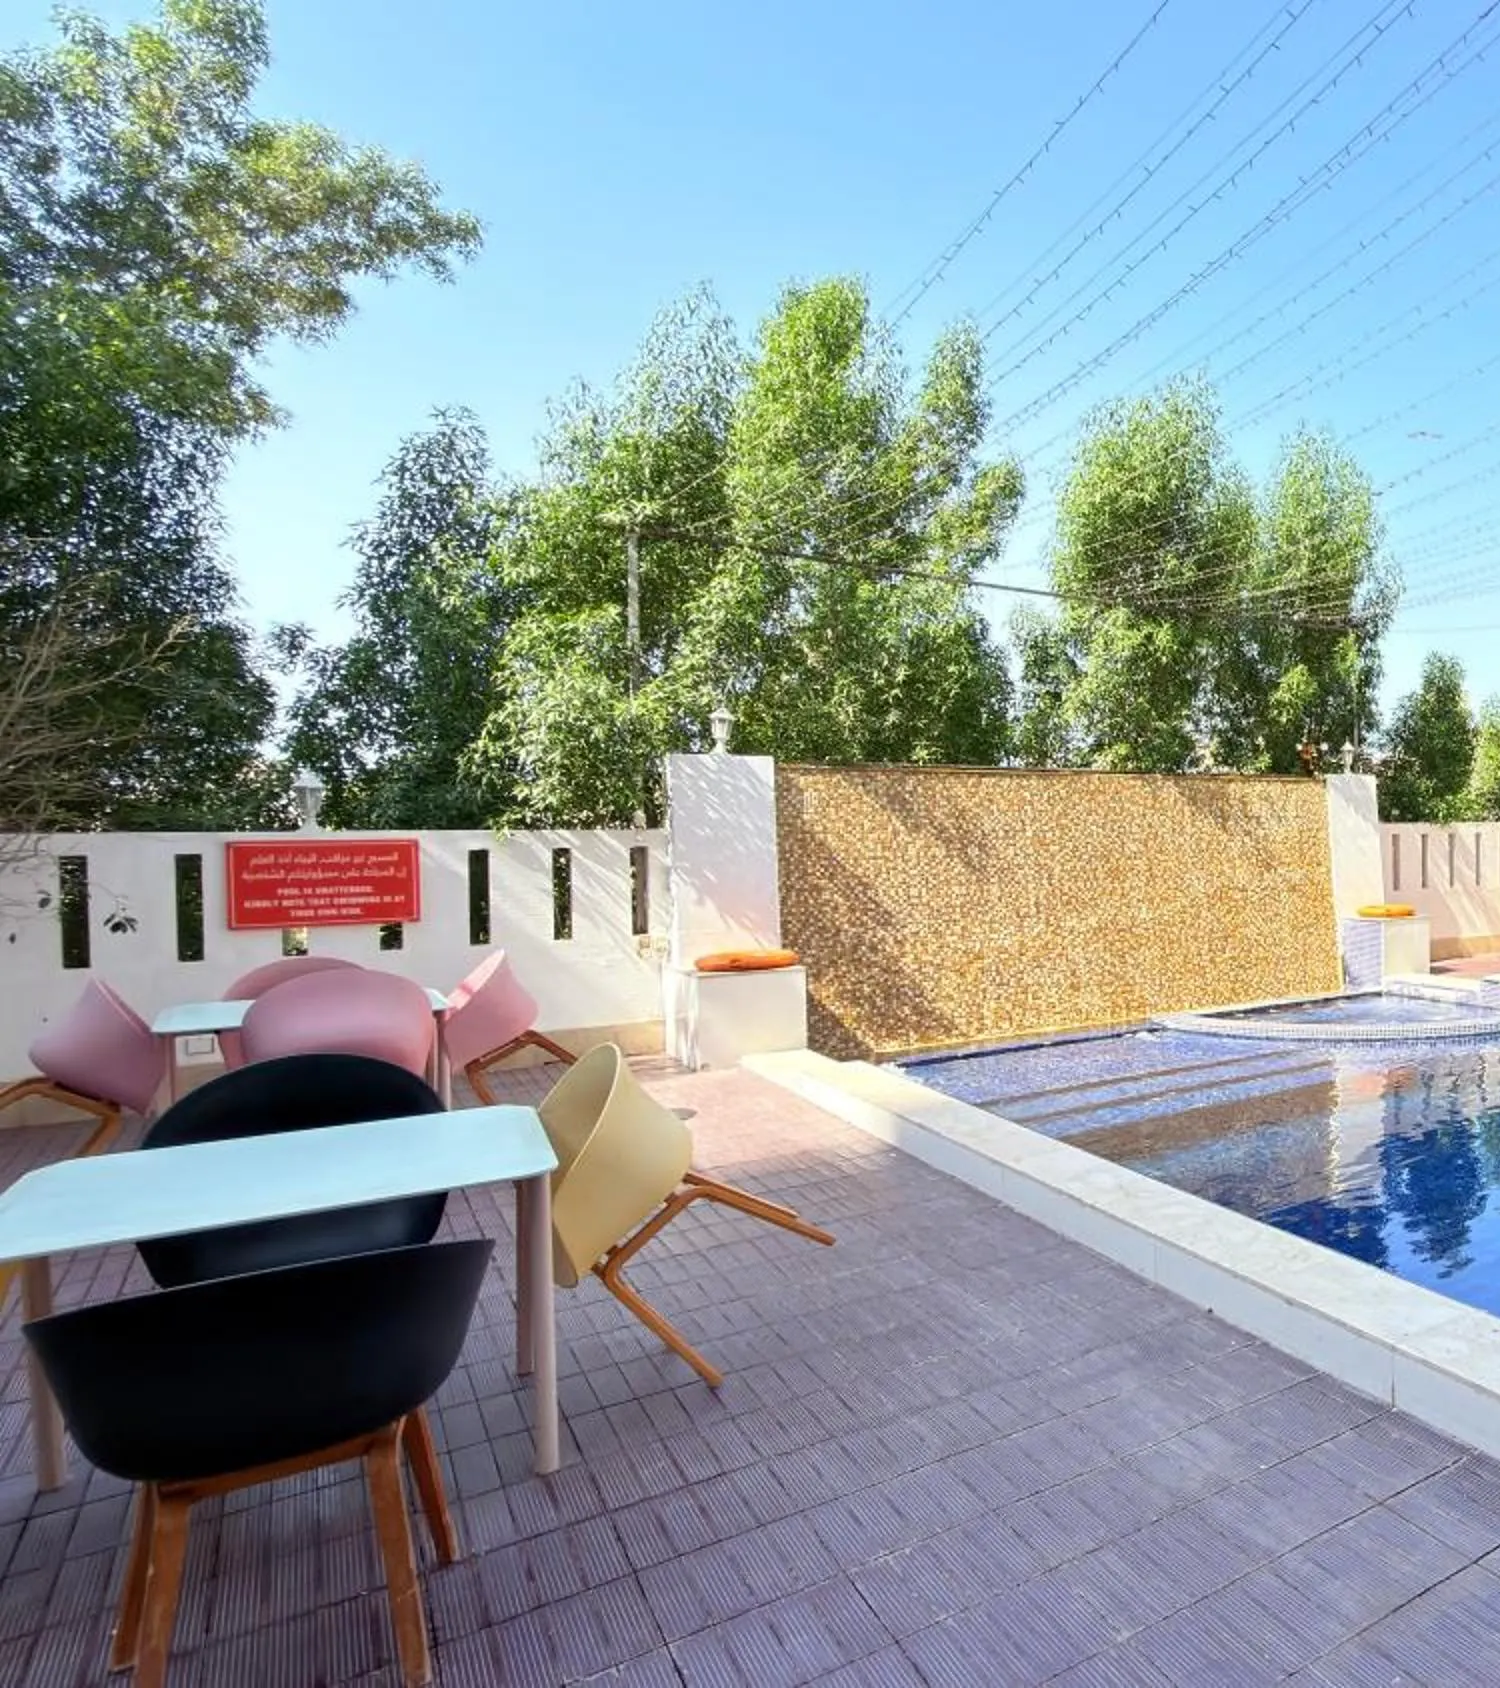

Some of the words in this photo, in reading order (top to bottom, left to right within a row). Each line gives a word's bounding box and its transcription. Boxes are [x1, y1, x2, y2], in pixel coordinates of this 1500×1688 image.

[277, 887, 301, 896] POOL
[243, 899, 279, 909] KINDLY
[281, 898, 306, 907] NOTE
[307, 897, 331, 906] THAT
